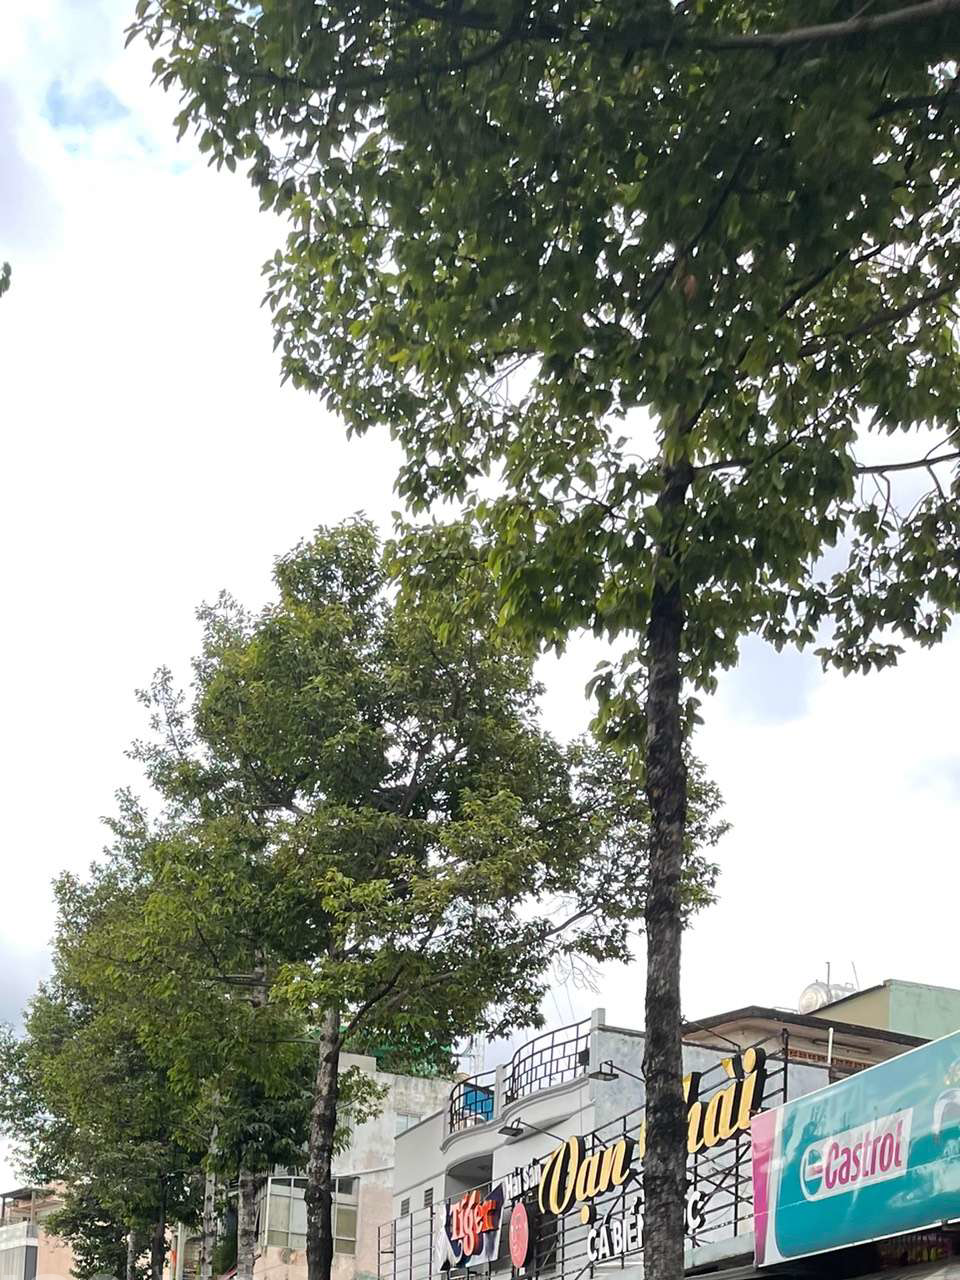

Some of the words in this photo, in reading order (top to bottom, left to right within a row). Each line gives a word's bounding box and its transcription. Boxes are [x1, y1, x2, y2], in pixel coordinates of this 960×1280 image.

[538, 1136, 630, 1225] Vạn
[824, 1119, 903, 1190] Castrol
[449, 1189, 497, 1257] Tiger
